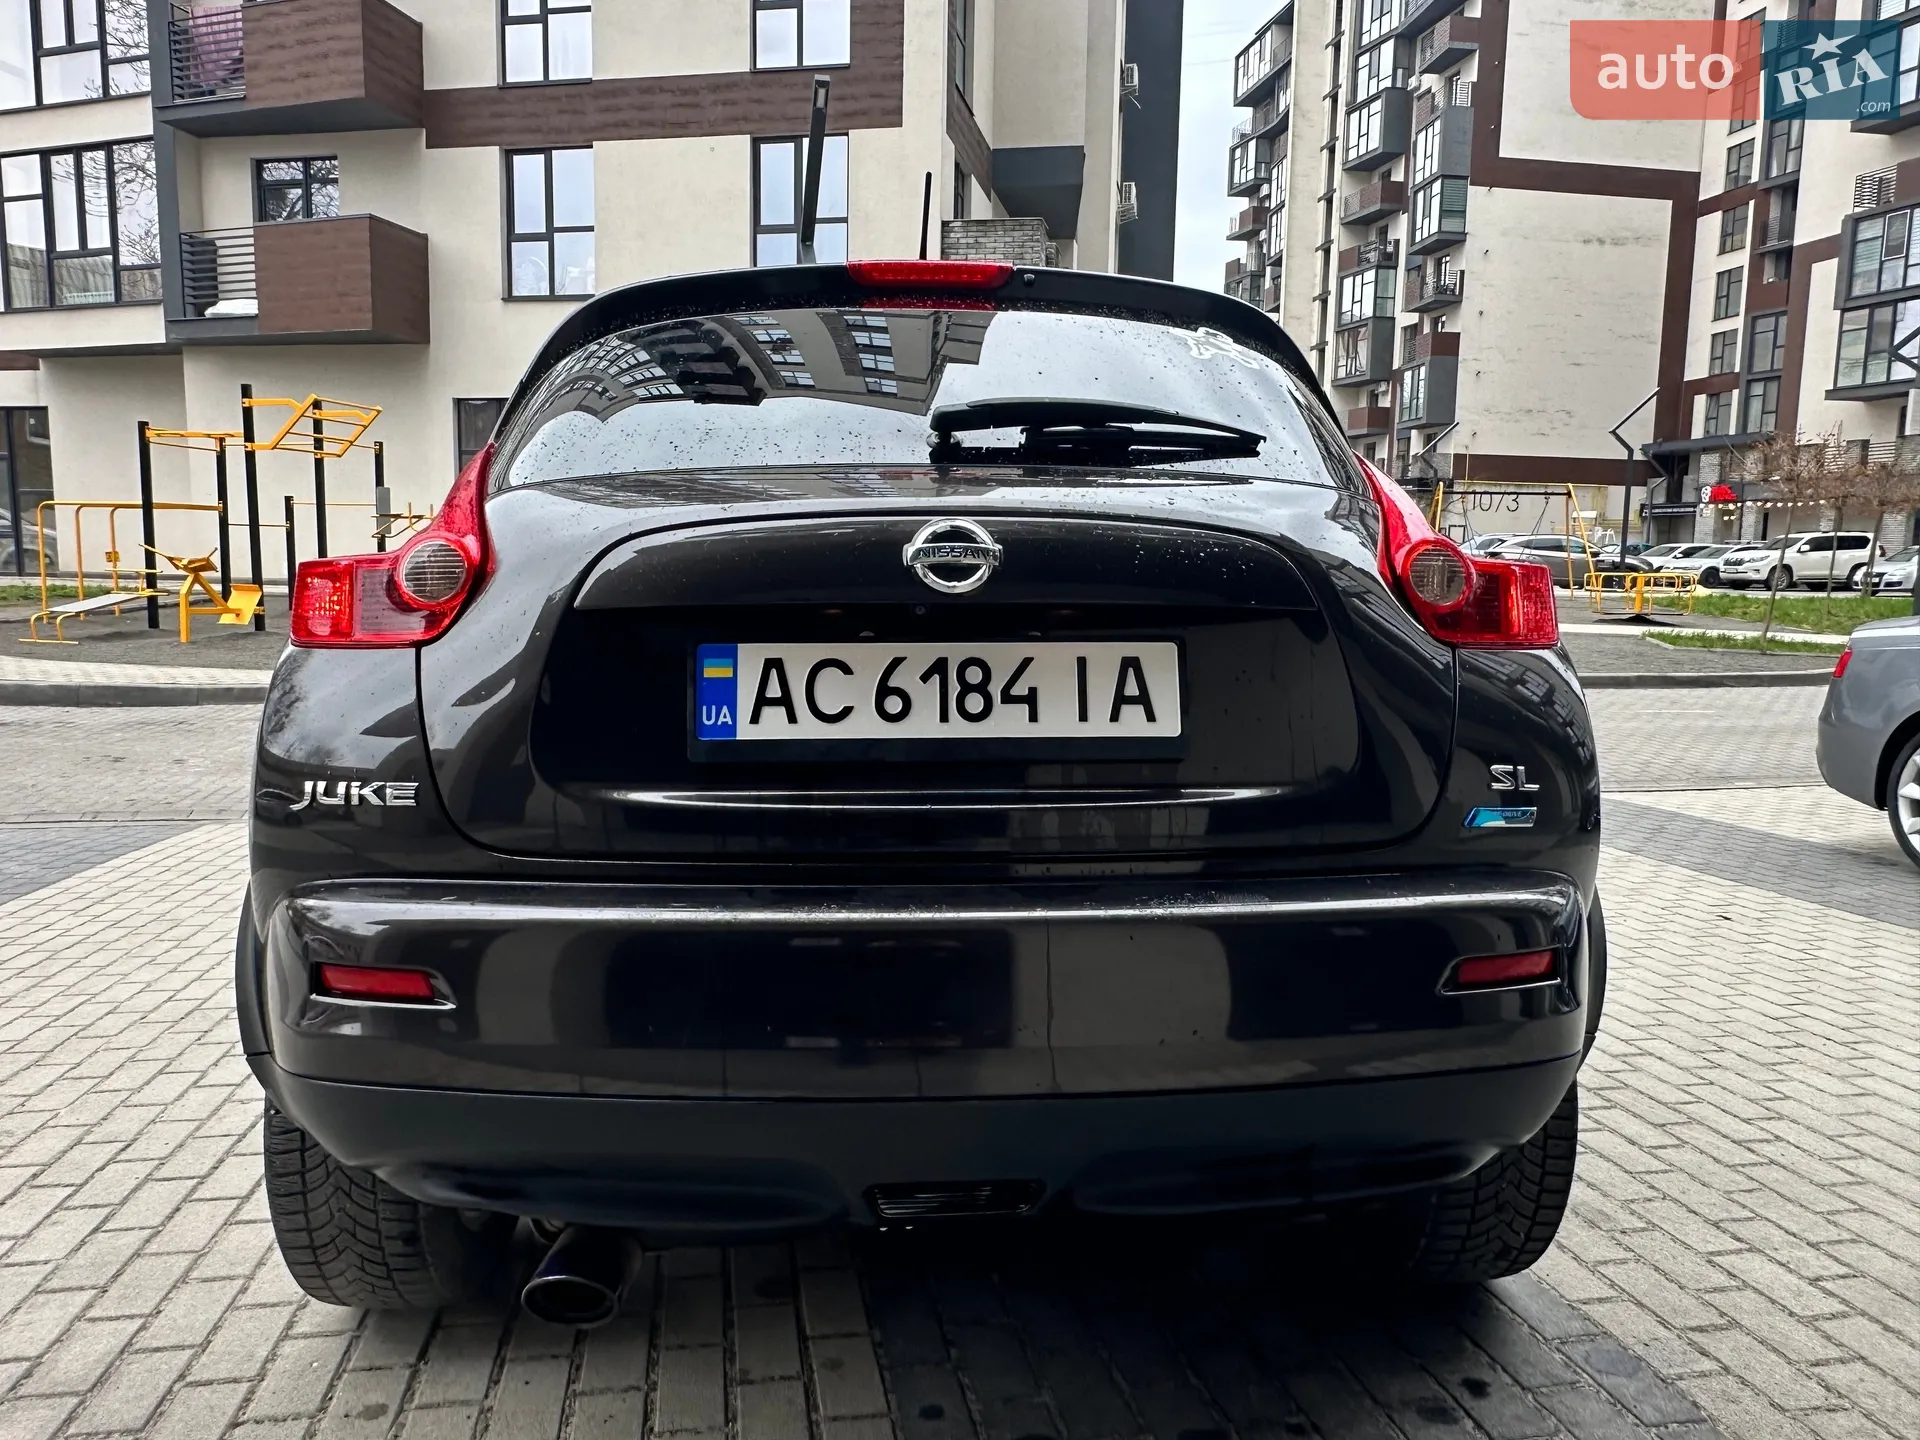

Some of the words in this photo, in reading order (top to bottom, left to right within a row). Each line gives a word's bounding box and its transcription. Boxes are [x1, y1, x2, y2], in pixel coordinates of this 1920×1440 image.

[1472, 488, 1520, 513] 10/3
[918, 545, 993, 559] NISSAN
[748, 657, 855, 725] AC
[874, 655, 1039, 724] 6184
[1076, 655, 1157, 723] IA
[702, 705, 733, 726] UA
[1489, 764, 1540, 791] SL
[289, 780, 420, 811] JUKE
